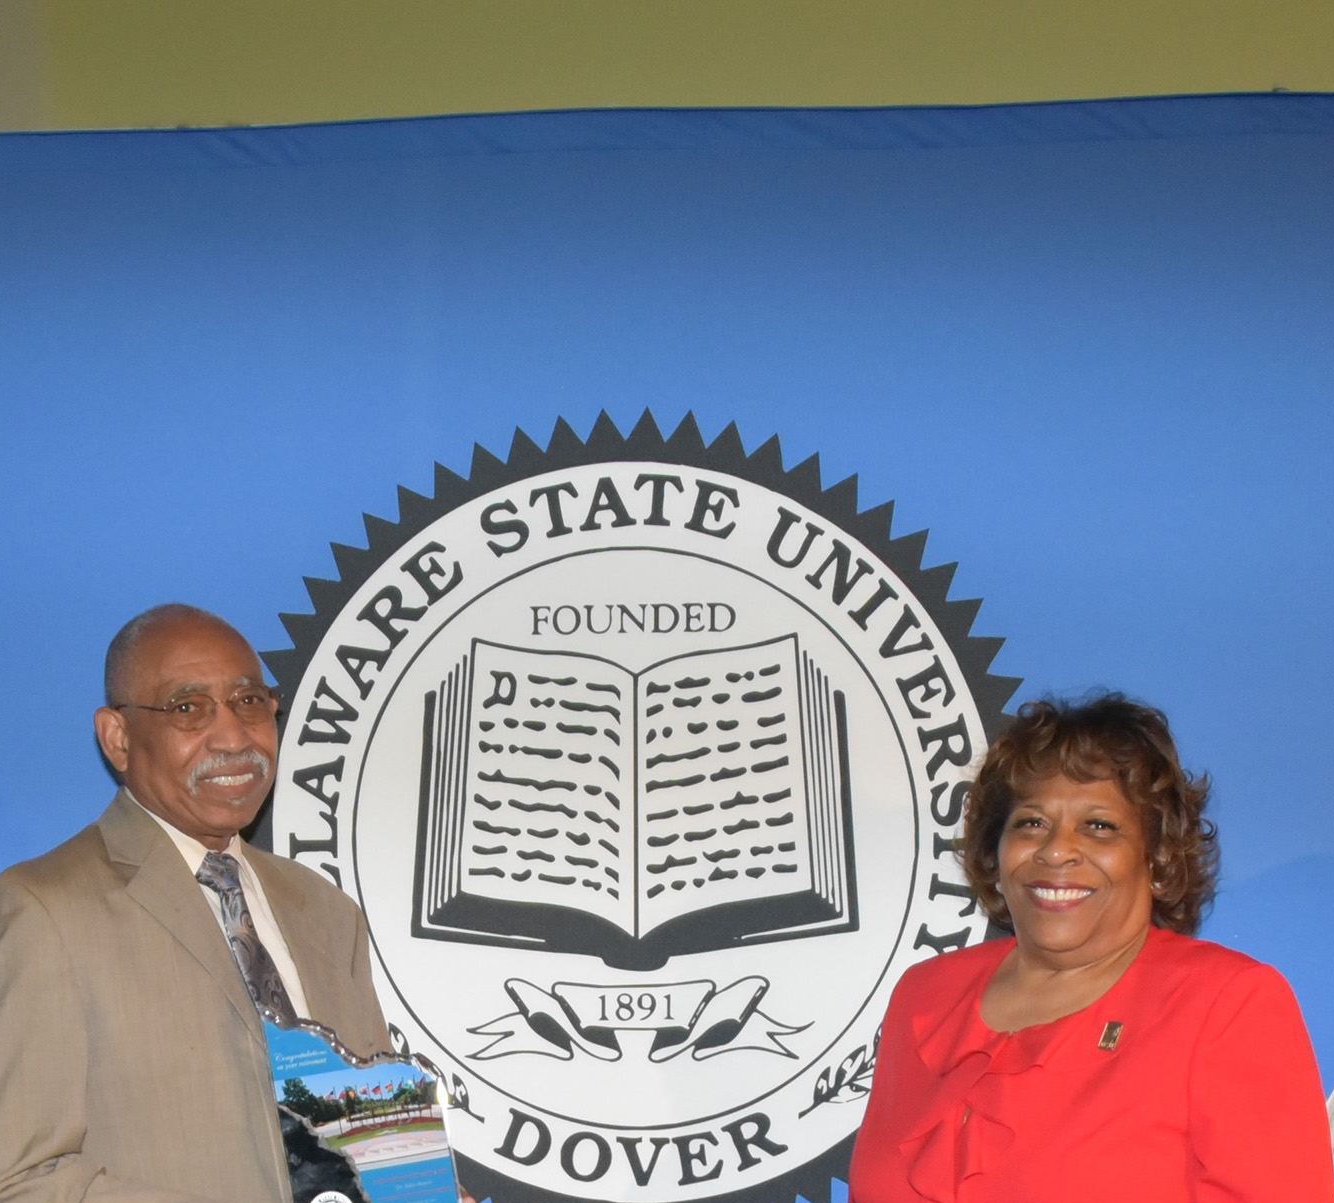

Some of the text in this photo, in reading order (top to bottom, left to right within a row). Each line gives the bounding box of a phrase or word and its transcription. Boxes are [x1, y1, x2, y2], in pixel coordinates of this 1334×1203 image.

[530, 603, 736, 635] FOUNDED
[290, 542, 463, 891] LAWARE
[481, 474, 739, 557] STATE
[598, 993, 675, 1021] 1891
[274, 1050, 327, 1063] Congratulations
[494, 1109, 788, 1186] DOVER
